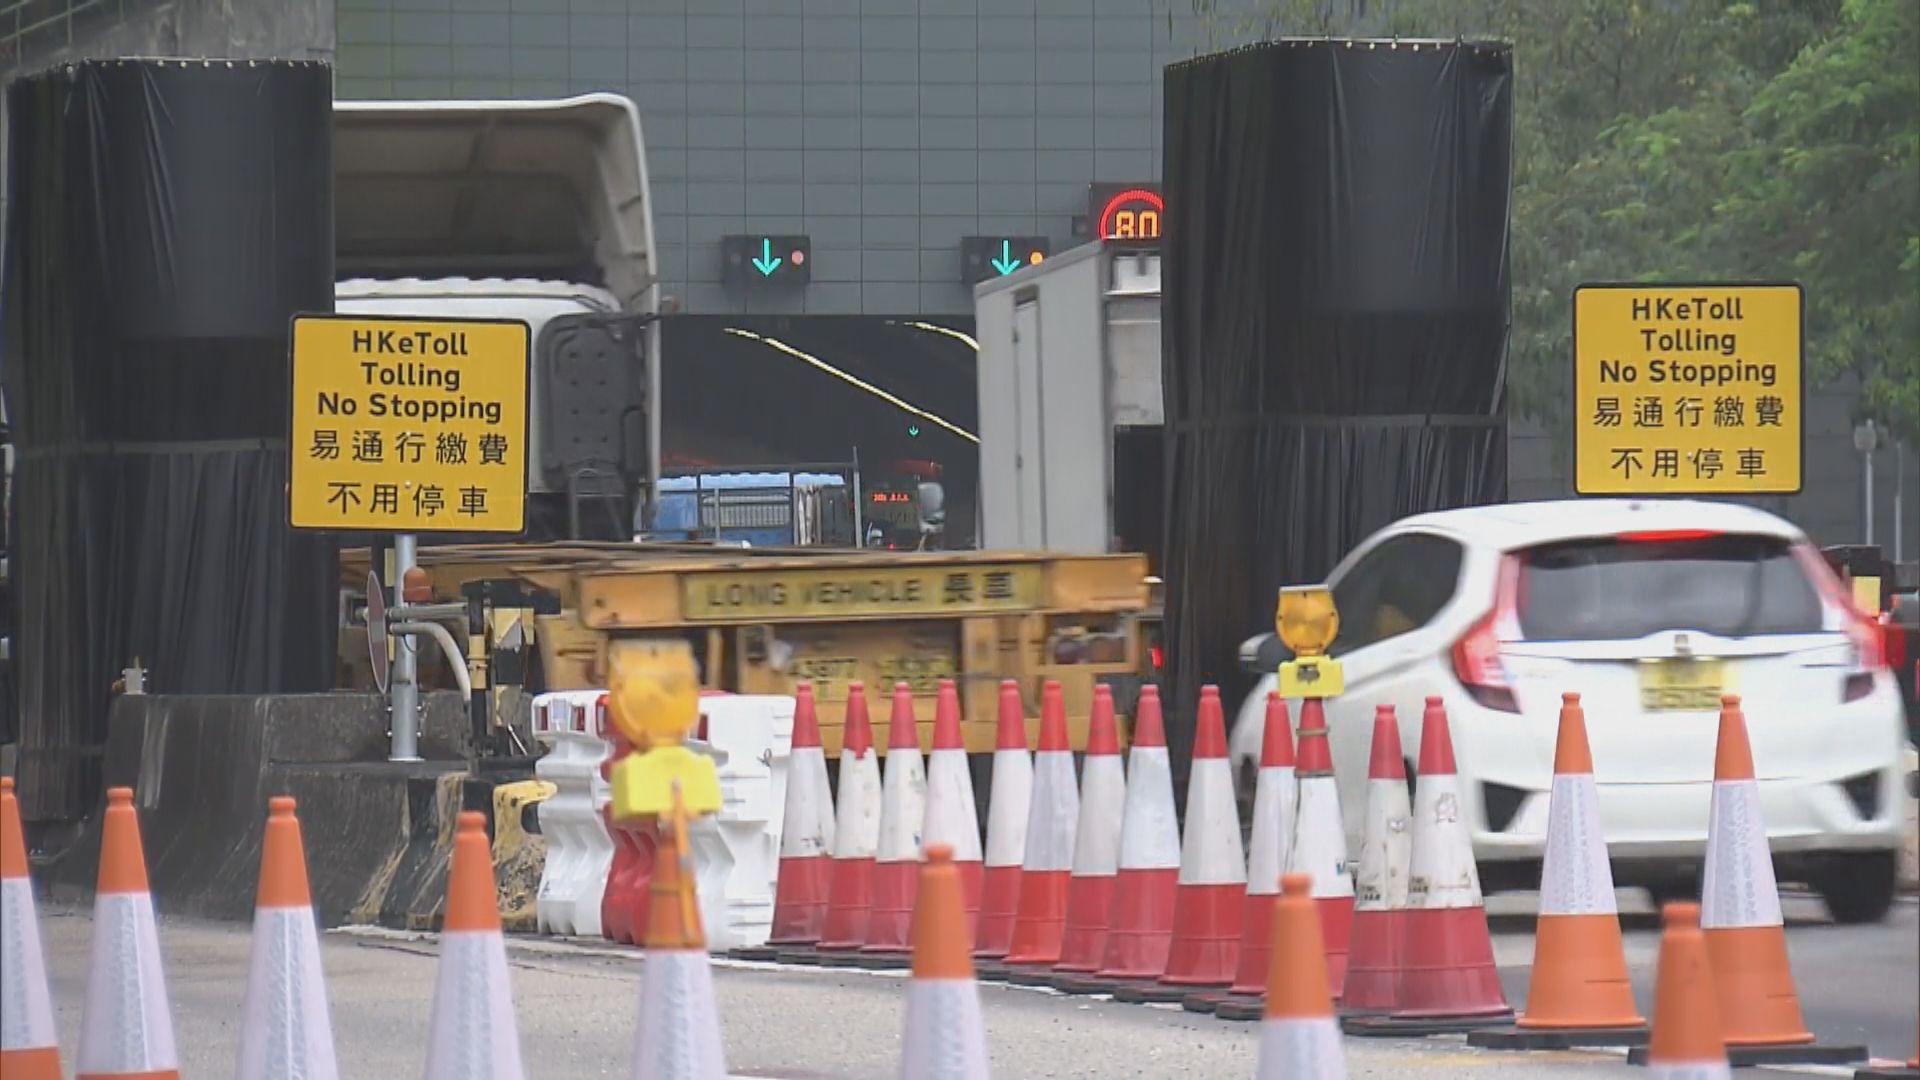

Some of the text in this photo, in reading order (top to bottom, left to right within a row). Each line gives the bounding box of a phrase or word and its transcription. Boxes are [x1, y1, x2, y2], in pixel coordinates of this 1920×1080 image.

[1632, 297, 1743, 320] HKeToll
[352, 330, 468, 355] HKeToll
[1640, 328, 1736, 355] Tolling
[361, 362, 460, 391] Tolling
[1600, 359, 1776, 387] No Stopping
[318, 392, 501, 424] No Stopping
[1593, 396, 1784, 427] 易通行繳費
[310, 430, 508, 465] 易通行繳費
[1611, 447, 1766, 479] 不用停車
[327, 481, 489, 517] 不用停車
[706, 571, 1014, 607] LONG VEHICLE 長車
